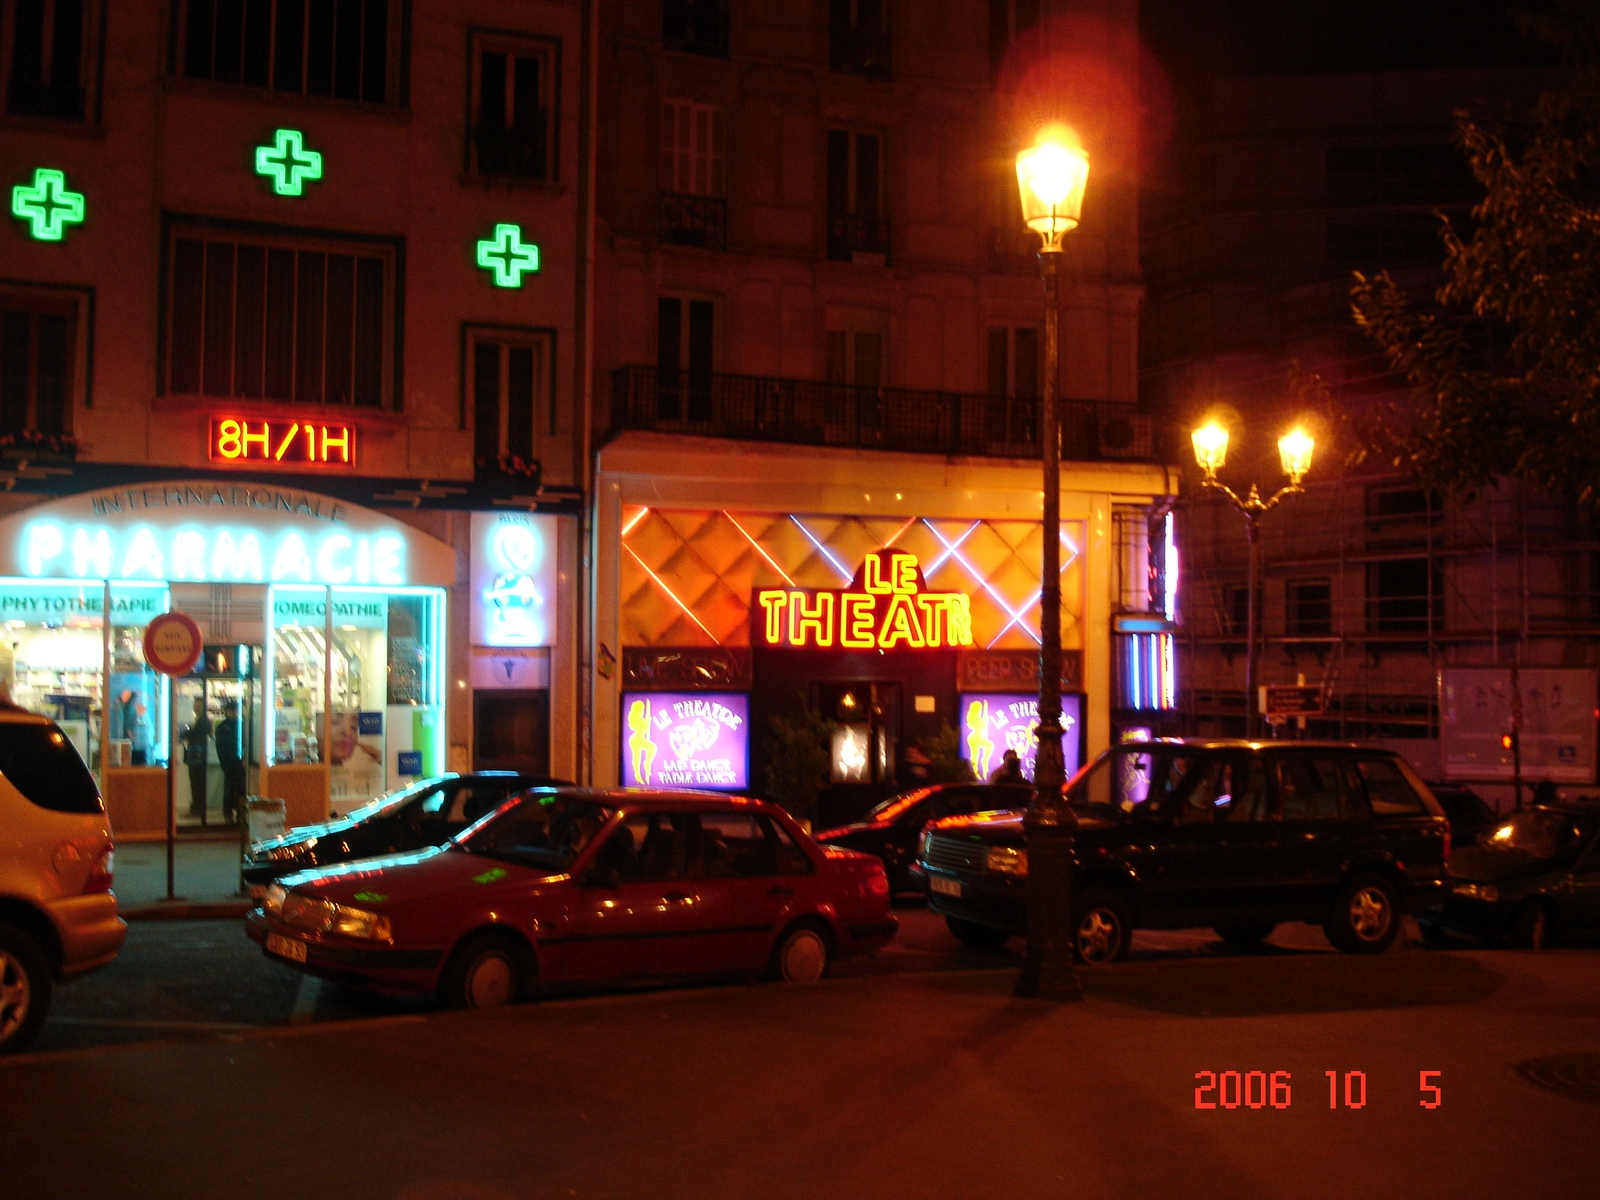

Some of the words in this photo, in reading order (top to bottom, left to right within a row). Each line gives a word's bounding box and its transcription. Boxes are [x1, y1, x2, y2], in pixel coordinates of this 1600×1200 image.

[218, 419, 349, 463] 8H/1H
[92, 486, 350, 525] INTERNATIONALE
[30, 523, 406, 584] PHARMACIE
[865, 553, 918, 594] LE
[652, 708, 673, 731] LE
[988, 707, 1010, 729] LE
[690, 758, 732, 772] DANCE
